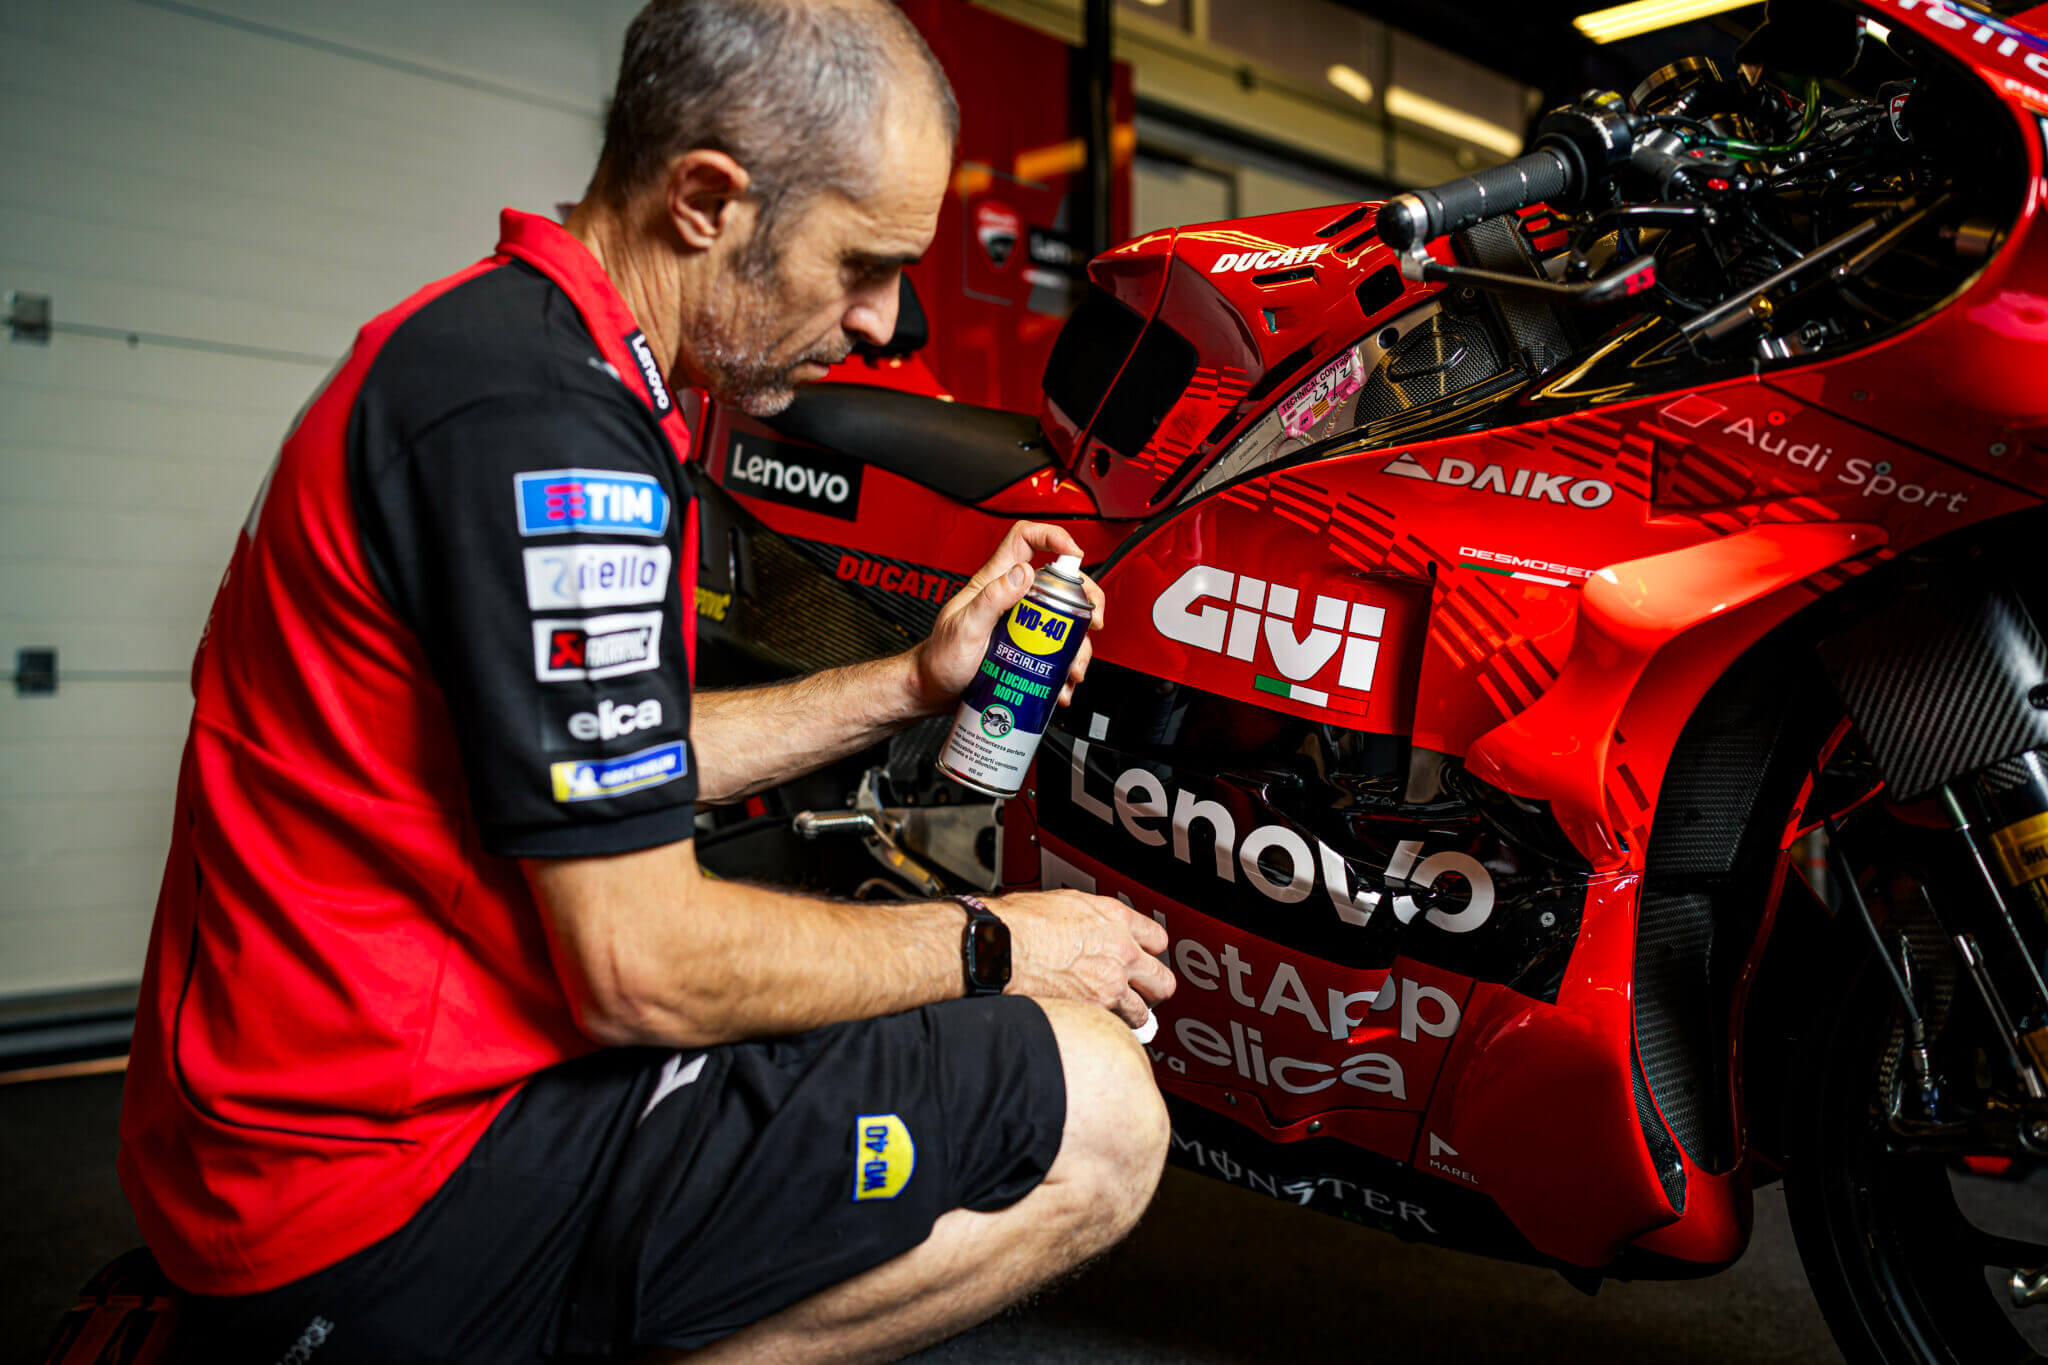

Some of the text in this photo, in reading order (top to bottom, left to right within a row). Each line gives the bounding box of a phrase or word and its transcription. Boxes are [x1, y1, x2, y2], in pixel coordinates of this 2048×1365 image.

[1210, 243, 1329, 274] DUCATI
[631, 334, 670, 411] Lenovo
[1281, 380, 1319, 413] TECHNICAL
[731, 443, 850, 504] Lenovo
[1436, 456, 1614, 508] DAIKO
[1722, 417, 1968, 514] Audi Sport
[584, 482, 654, 524] TIM
[835, 554, 950, 604] DUCATI
[1014, 602, 1067, 641] WD-40
[995, 643, 1053, 676] SPECIALIST
[1000, 669, 1052, 700] LUCIDANTE
[993, 684, 1024, 706] MOTO
[1071, 712, 1496, 934] Lenovo
[1117, 891, 1461, 1043] etApp
[1174, 1017, 1408, 1101] elica
[863, 1125, 889, 1192] WD-40
[1429, 1158, 1480, 1185] MAREL
